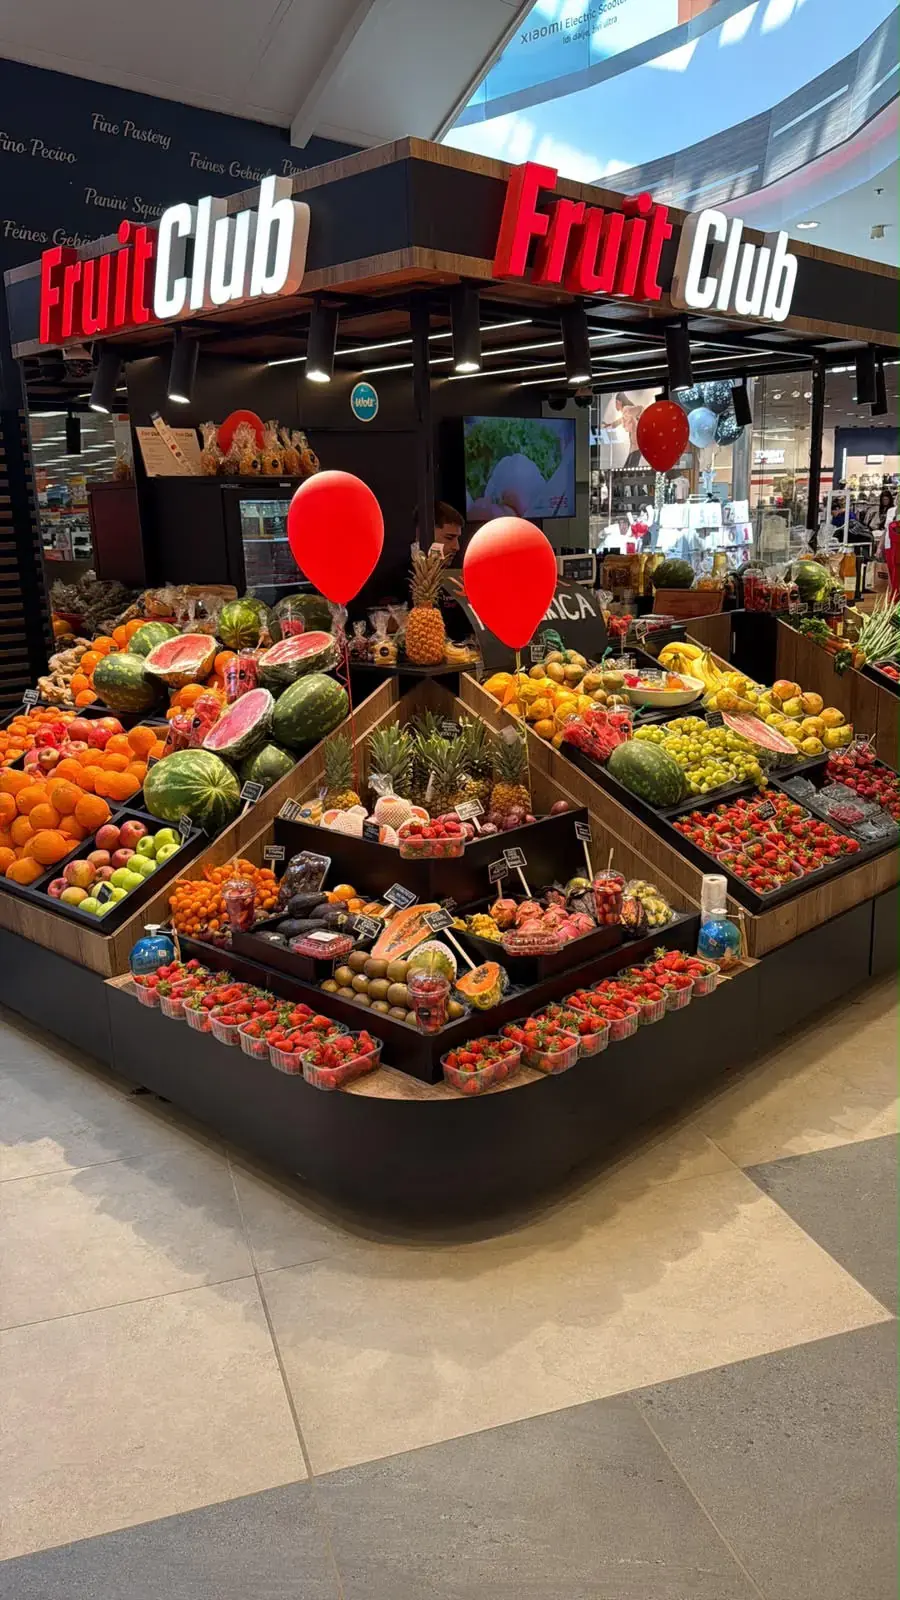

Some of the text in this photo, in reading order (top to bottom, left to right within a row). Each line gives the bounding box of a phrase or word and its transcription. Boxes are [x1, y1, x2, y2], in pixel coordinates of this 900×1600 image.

[565, 9, 597, 29] Electric
[91, 112, 171, 149] Fine Pastery
[30, 138, 77, 164] Pecivo
[189, 151, 225, 174] Feines
[84, 187, 128, 210] Panini
[3, 219, 48, 244] Feines
[494, 161, 798, 323] Fruit Club
[39, 174, 300, 345] Fruit Club
